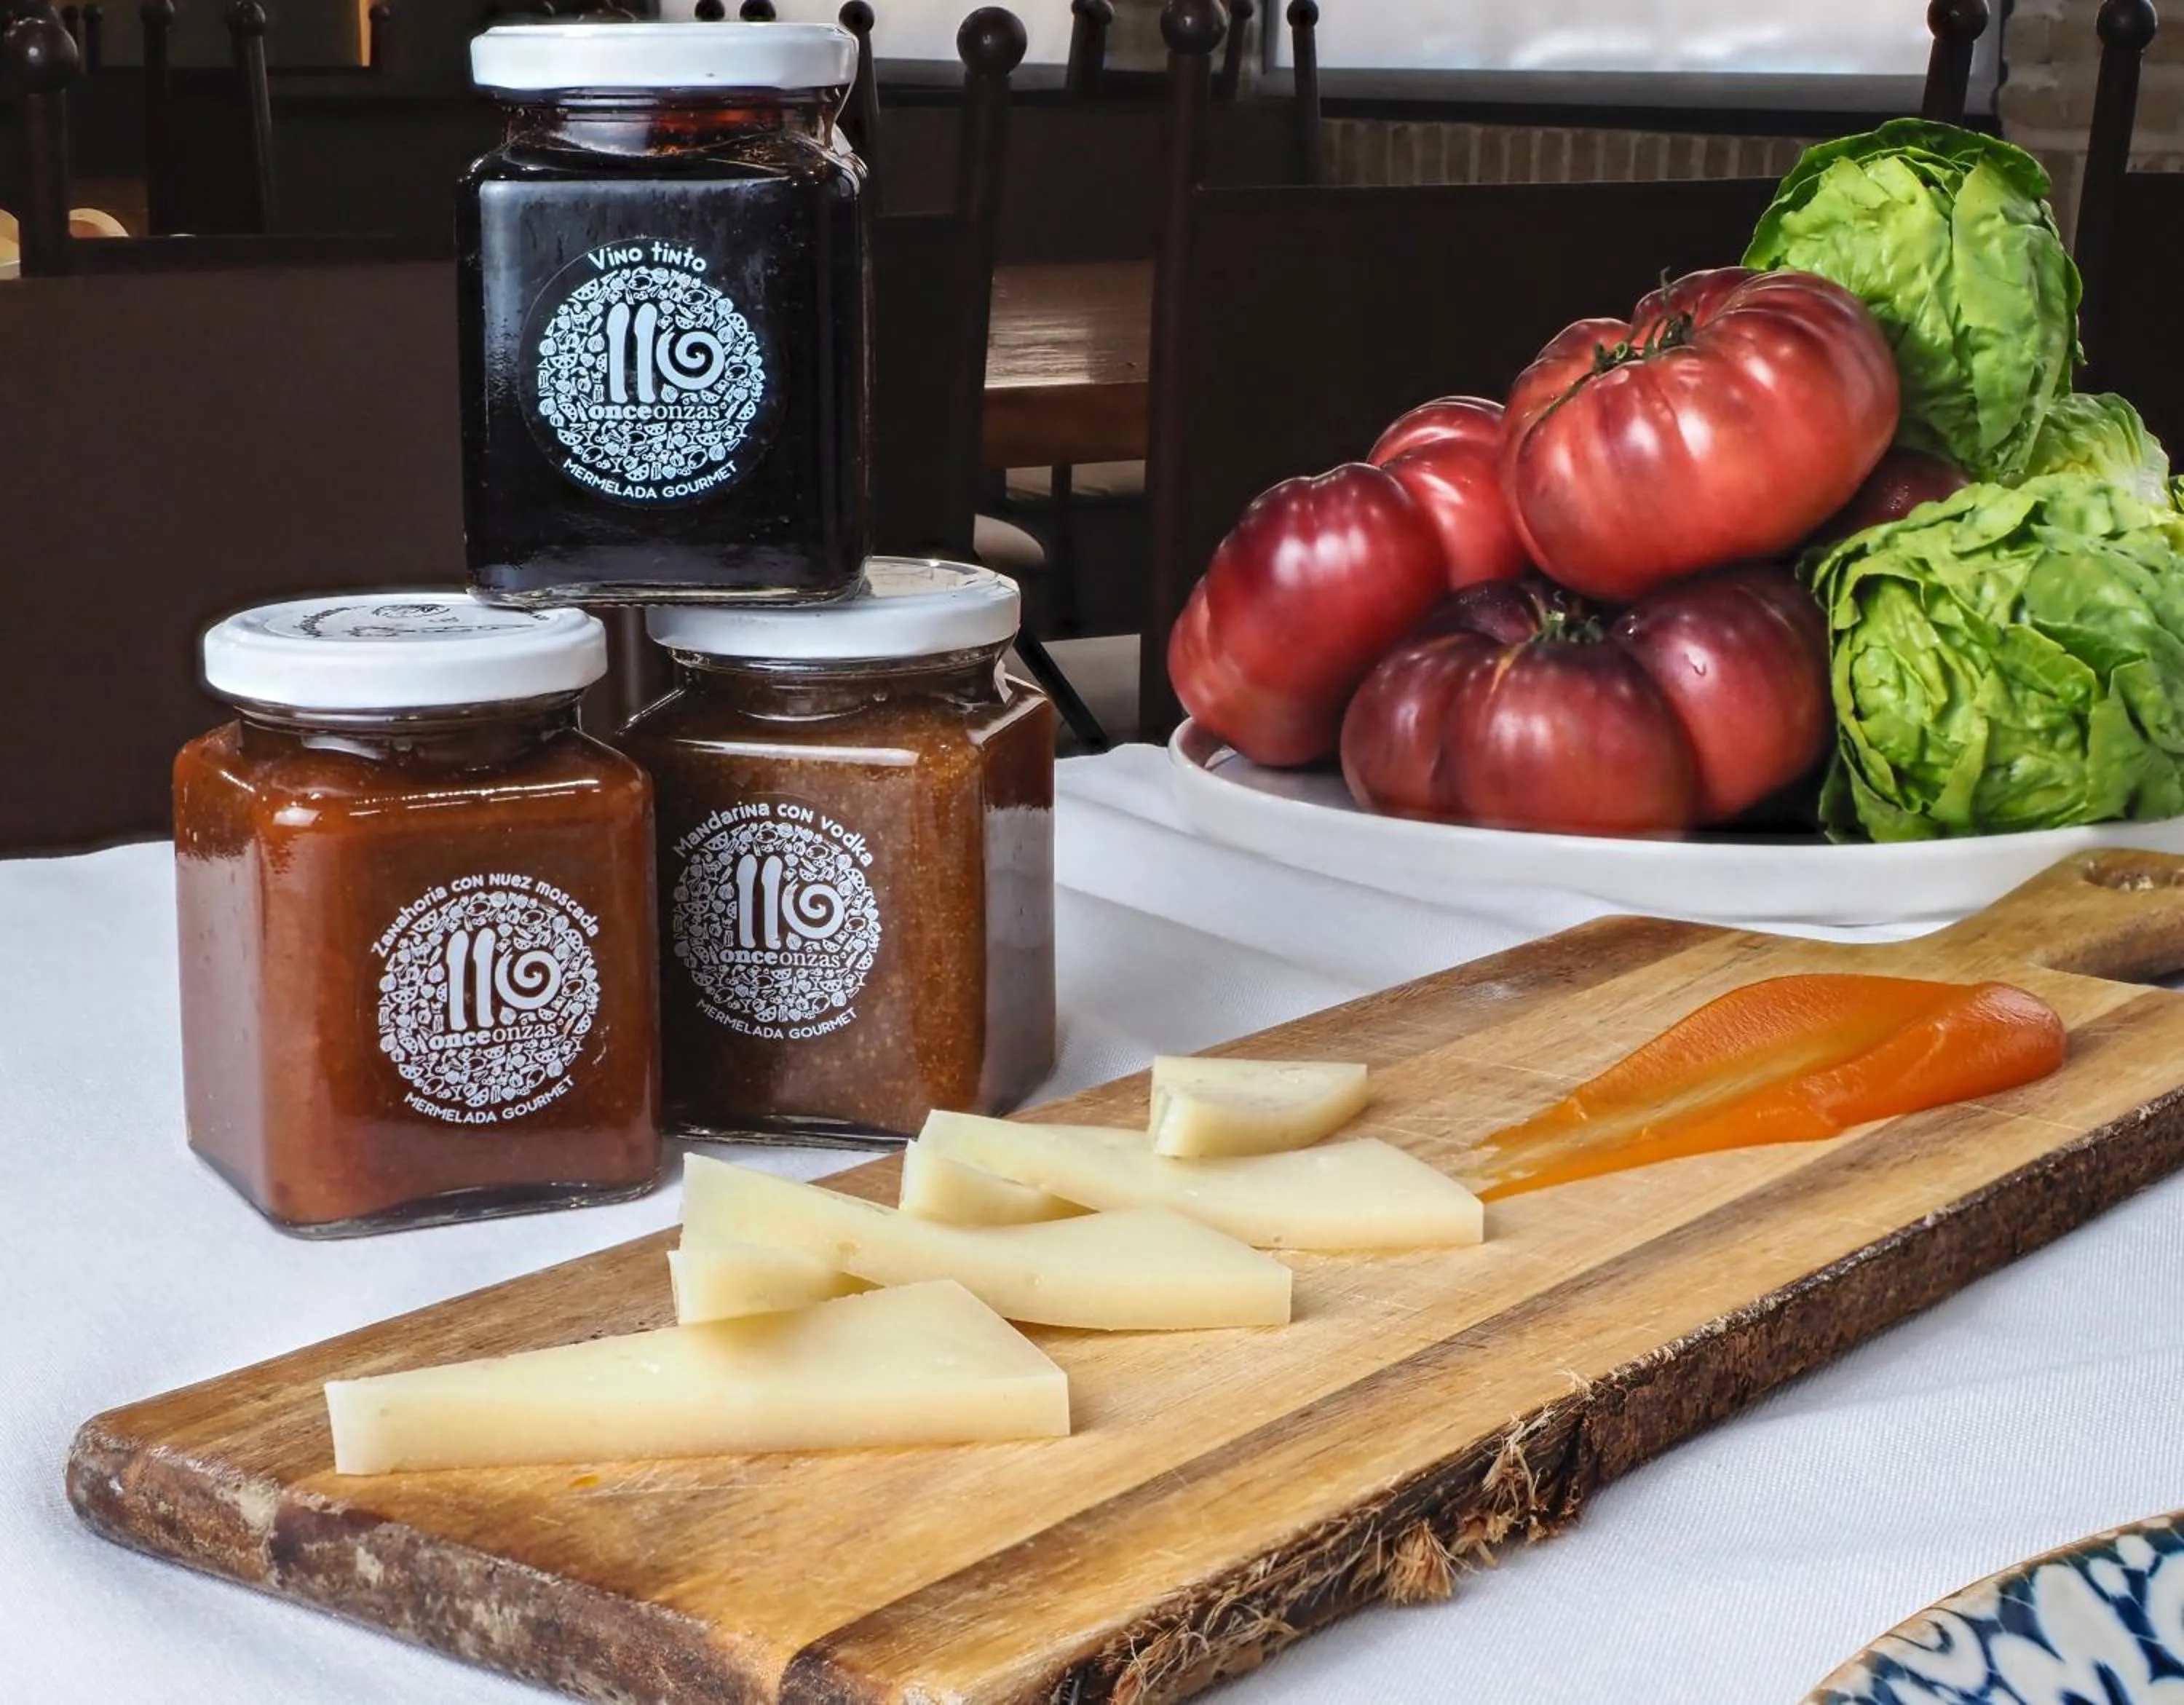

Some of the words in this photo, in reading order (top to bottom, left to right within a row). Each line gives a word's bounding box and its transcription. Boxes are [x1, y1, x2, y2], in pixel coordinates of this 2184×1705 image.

[588, 405, 720, 420] onceonzas
[563, 458, 657, 499] MERMELADA
[662, 459, 737, 498] GOURMET
[535, 881, 599, 938] moscada
[719, 949, 841, 968] onceonzas
[428, 1023, 558, 1050] onceonzas
[696, 998, 784, 1040] MERMELADA
[789, 1008, 858, 1039] GOURMET
[403, 1093, 497, 1124] MERMELADA
[502, 1075, 575, 1120] GOURMET
